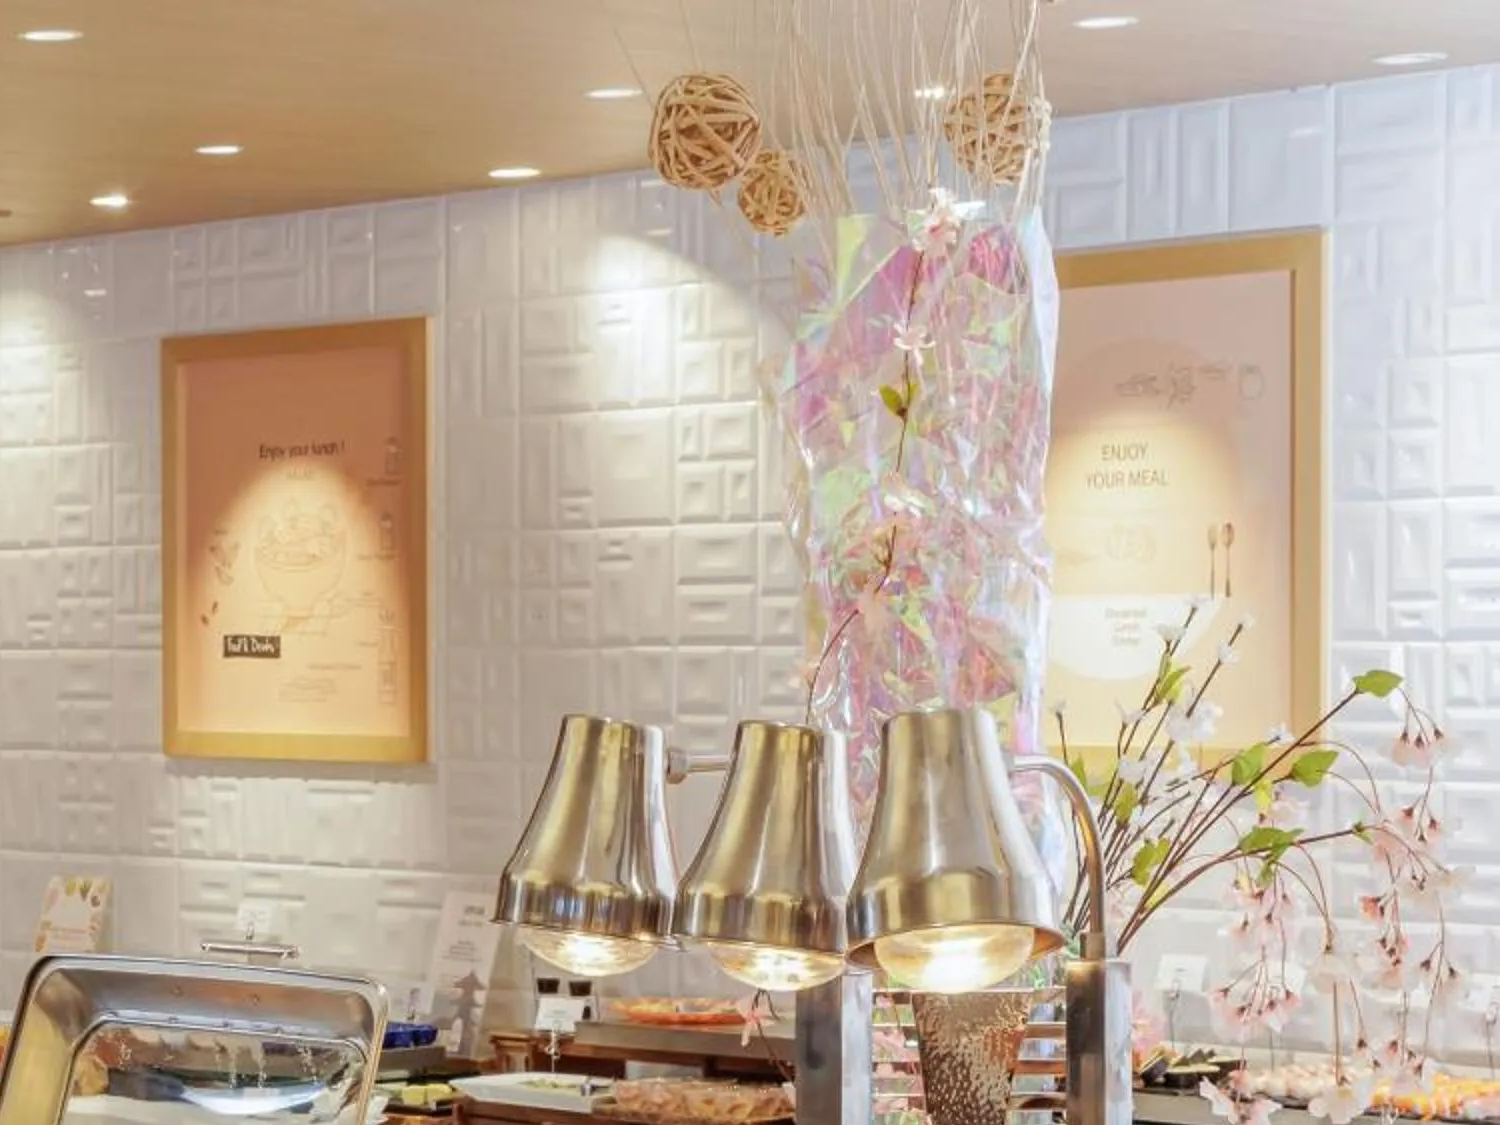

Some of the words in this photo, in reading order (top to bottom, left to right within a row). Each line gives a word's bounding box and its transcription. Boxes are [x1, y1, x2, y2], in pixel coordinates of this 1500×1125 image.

[1101, 441, 1149, 461] ENJOY
[1086, 469, 1125, 489] YOUR
[1128, 467, 1169, 487] MEAL
